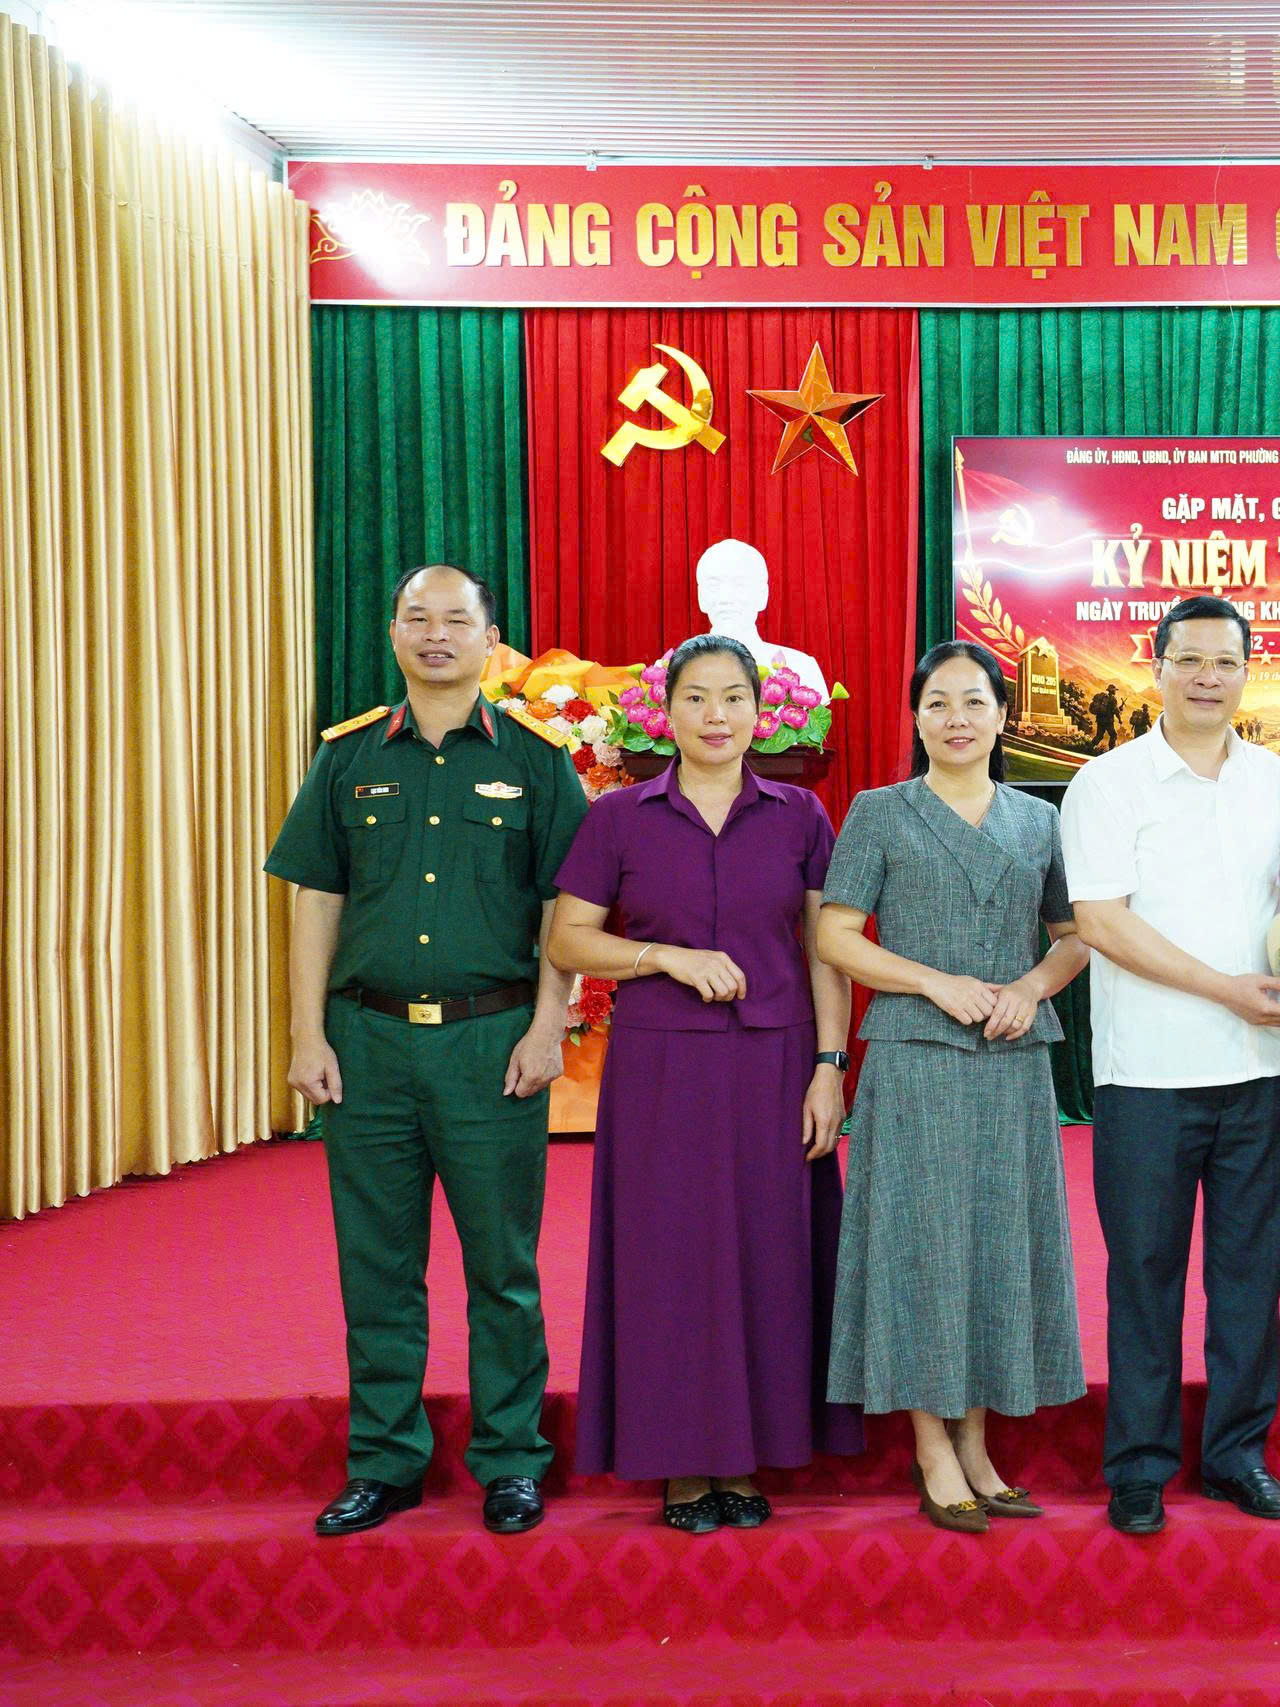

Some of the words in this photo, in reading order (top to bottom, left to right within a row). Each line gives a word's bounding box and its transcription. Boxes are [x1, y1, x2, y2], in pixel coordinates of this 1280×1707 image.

[443, 180, 612, 268] ĐẢNG
[635, 185, 800, 280] CỘNG
[822, 181, 946, 268] SẢN
[968, 190, 1091, 280] VIỆT
[1113, 203, 1250, 267] NAM
[1066, 447, 1093, 464] ĐẢNG
[1094, 447, 1110, 465] ỦY,
[1111, 450, 1141, 465] HĐND,
[1142, 450, 1172, 465] UBND,
[1173, 447, 1187, 464] ỦY
[1187, 450, 1208, 464] BAN
[1209, 450, 1238, 464] MTTQ
[1239, 447, 1279, 464] PHƯỜNG
[1162, 493, 1206, 524] GẶP
[1211, 493, 1266, 524] MẶT,
[1091, 523, 1151, 588] KỶ
[1160, 530, 1268, 595] NIỆM
[1076, 598, 1123, 621] NGÀY
[1128, 595, 1181, 621] TRUY
